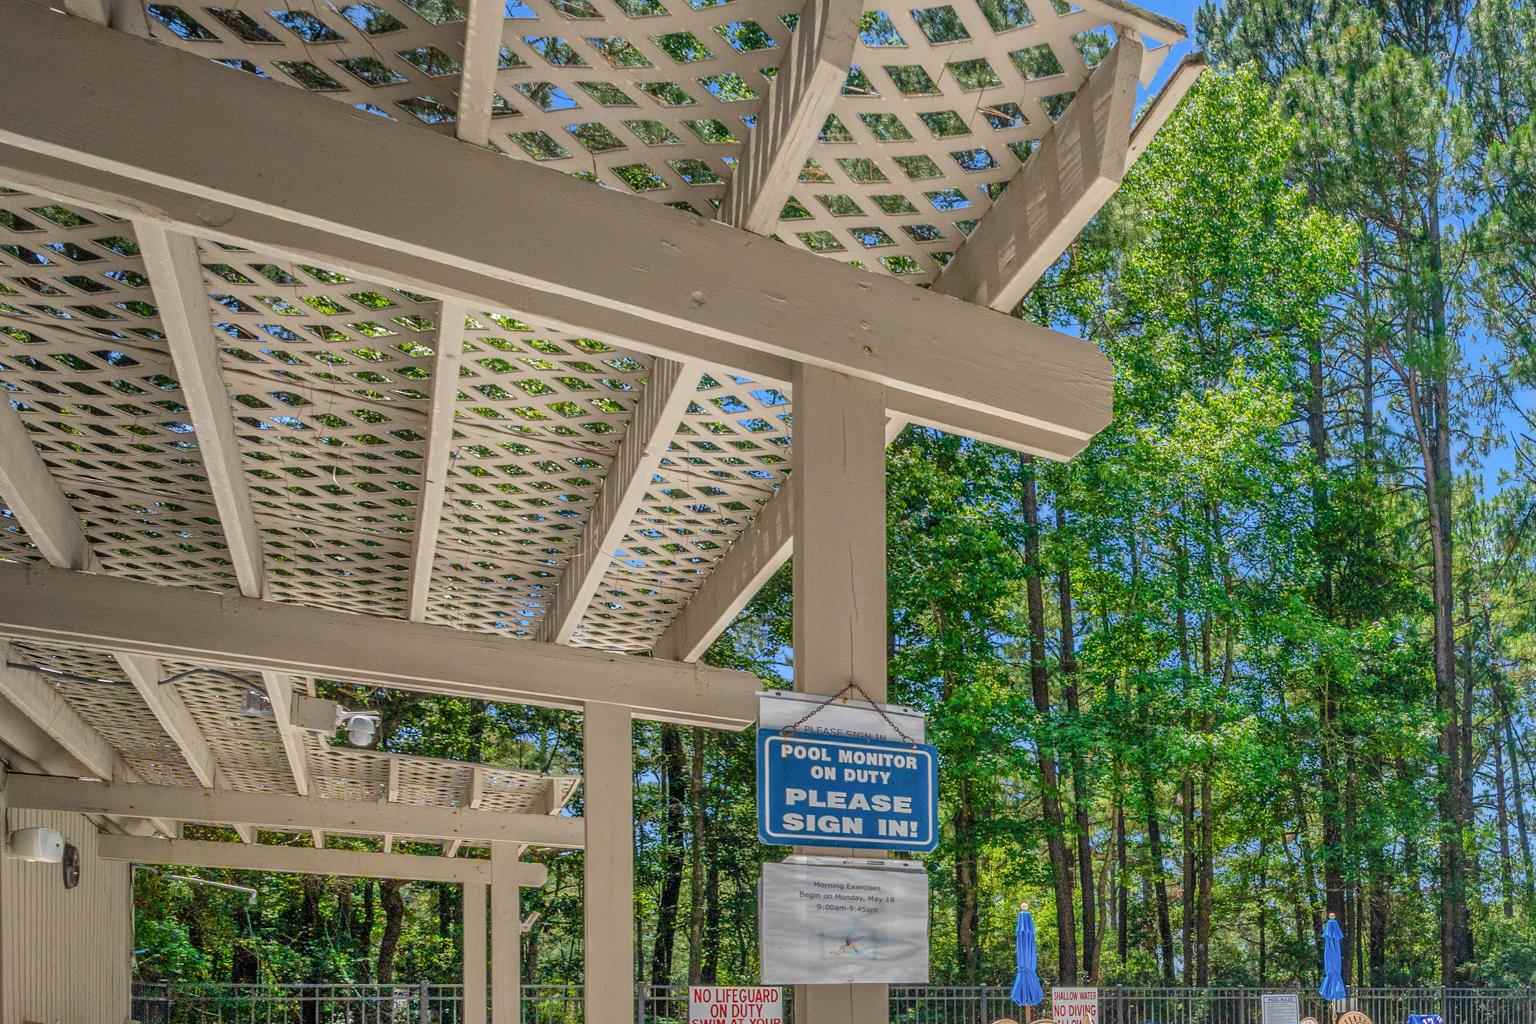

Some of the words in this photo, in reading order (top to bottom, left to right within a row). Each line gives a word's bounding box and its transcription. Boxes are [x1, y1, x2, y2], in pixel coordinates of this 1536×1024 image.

[780, 744, 832, 762] POOL
[838, 749, 918, 770] MONITOR
[810, 766, 836, 781] ON
[843, 769, 891, 785] DUTY
[785, 788, 913, 813] PLEASE
[782, 813, 863, 834] SIGN
[878, 819, 918, 838] IN!
[813, 881, 845, 891] Morning
[800, 890, 821, 900] Begin
[835, 894, 865, 903] Monday,
[868, 896, 883, 904] May
[694, 989, 712, 1003] NO
[715, 989, 778, 1003] LIFEGUARD
[1054, 992, 1078, 1000] SHALLOW
[1079, 992, 1096, 1000] WATER
[710, 1004, 727, 1018] ON
[732, 1004, 764, 1018] DUTY
[1054, 1005, 1066, 1017] NO
[1068, 1004, 1096, 1017] DIVING
